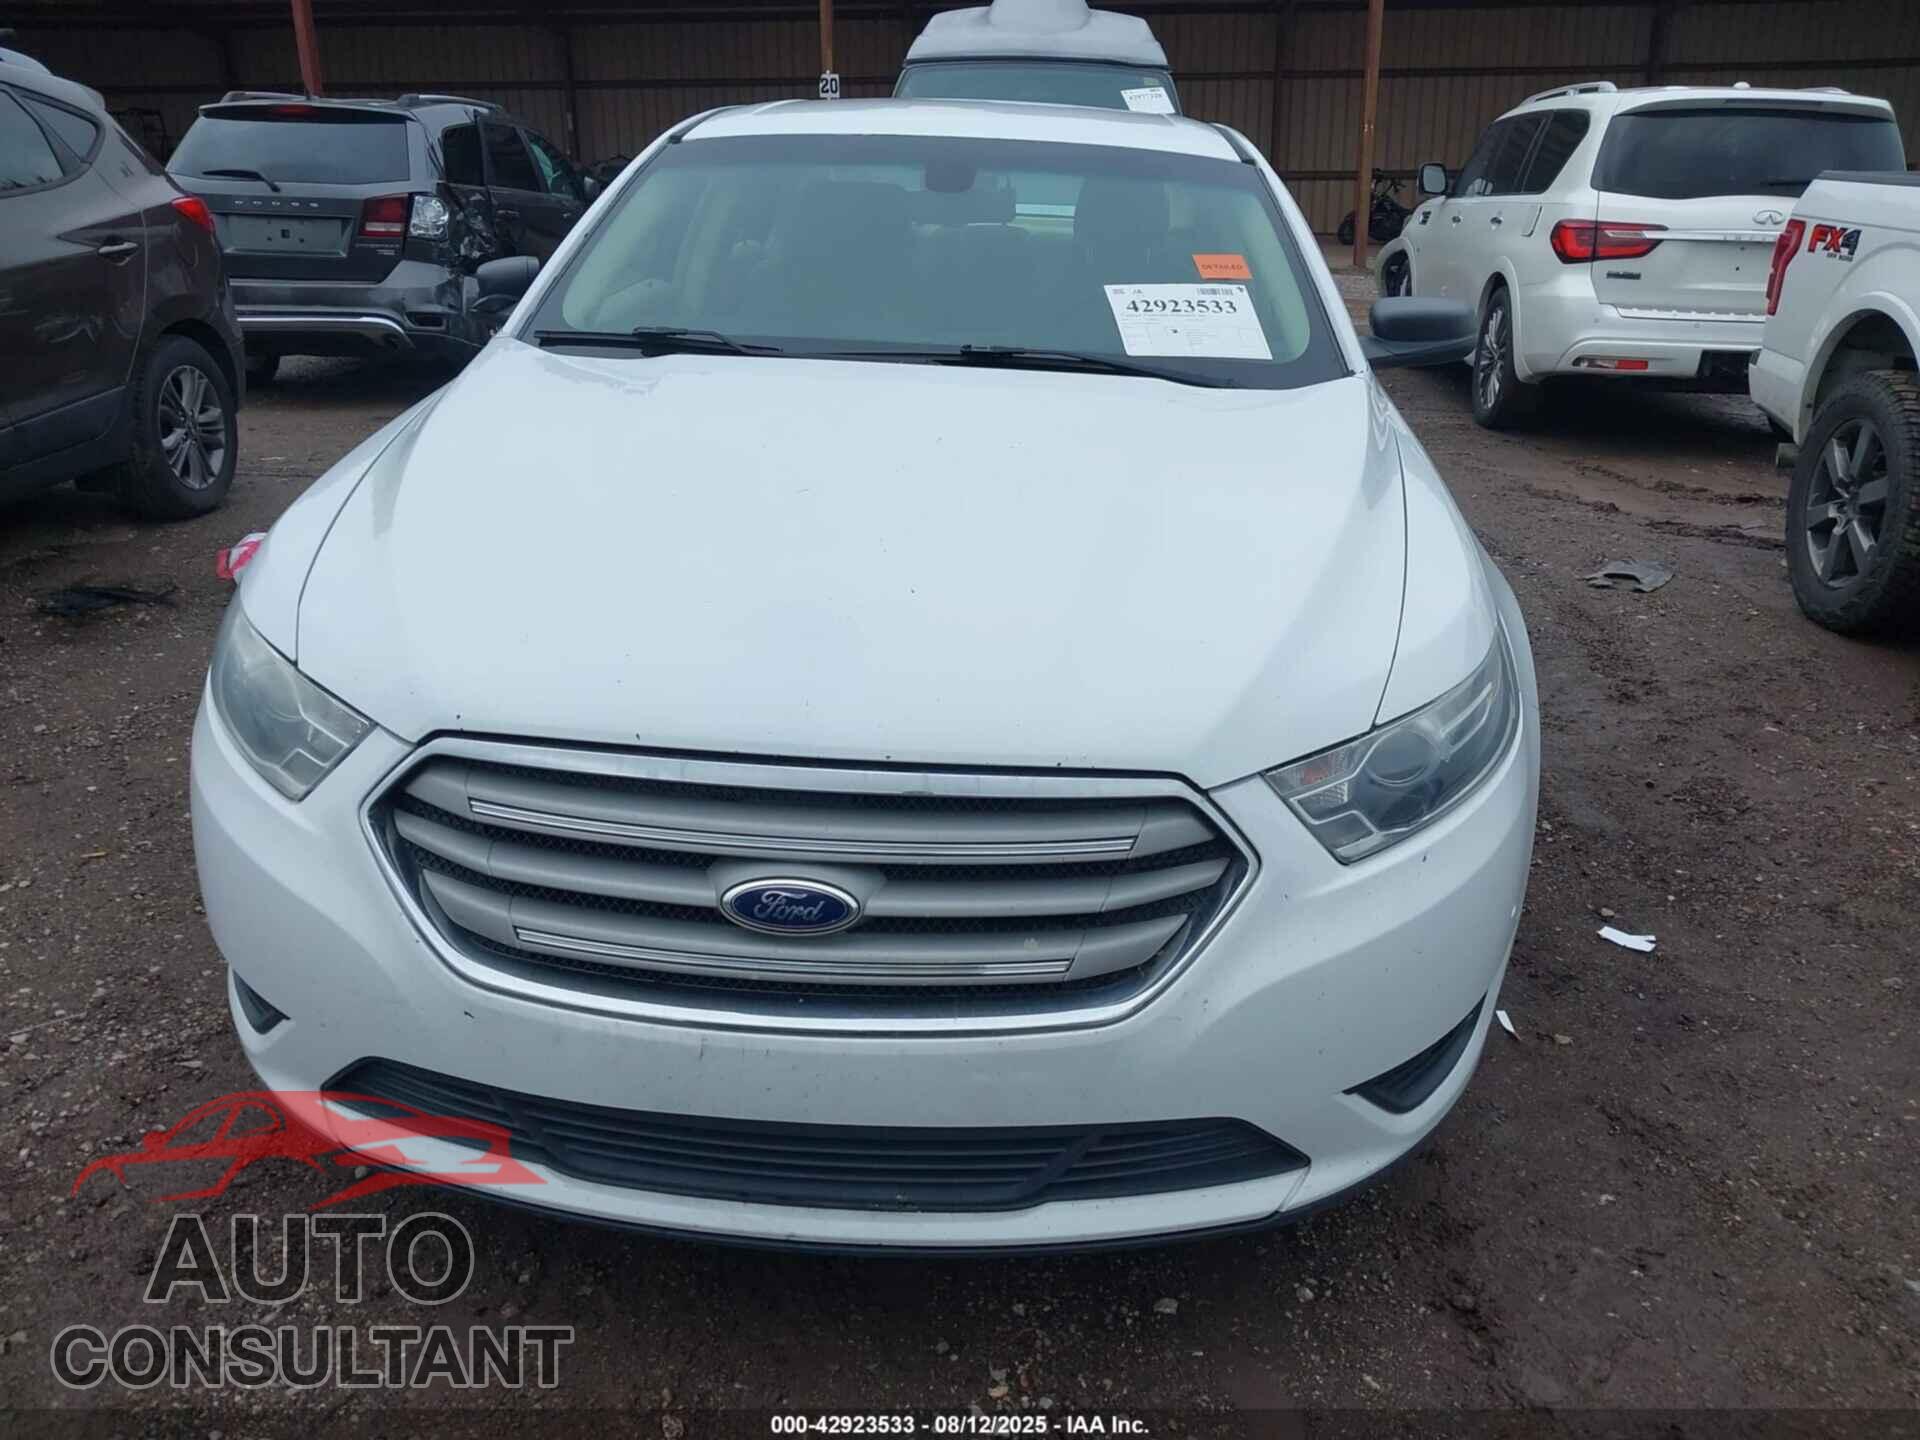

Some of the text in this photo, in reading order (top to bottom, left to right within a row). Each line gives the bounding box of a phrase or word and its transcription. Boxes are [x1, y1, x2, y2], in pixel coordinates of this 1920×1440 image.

[820, 77, 838, 94] 20
[1807, 223, 1862, 256] FX4
[1126, 299, 1237, 314] 42923533
[753, 890, 826, 921] Ford
